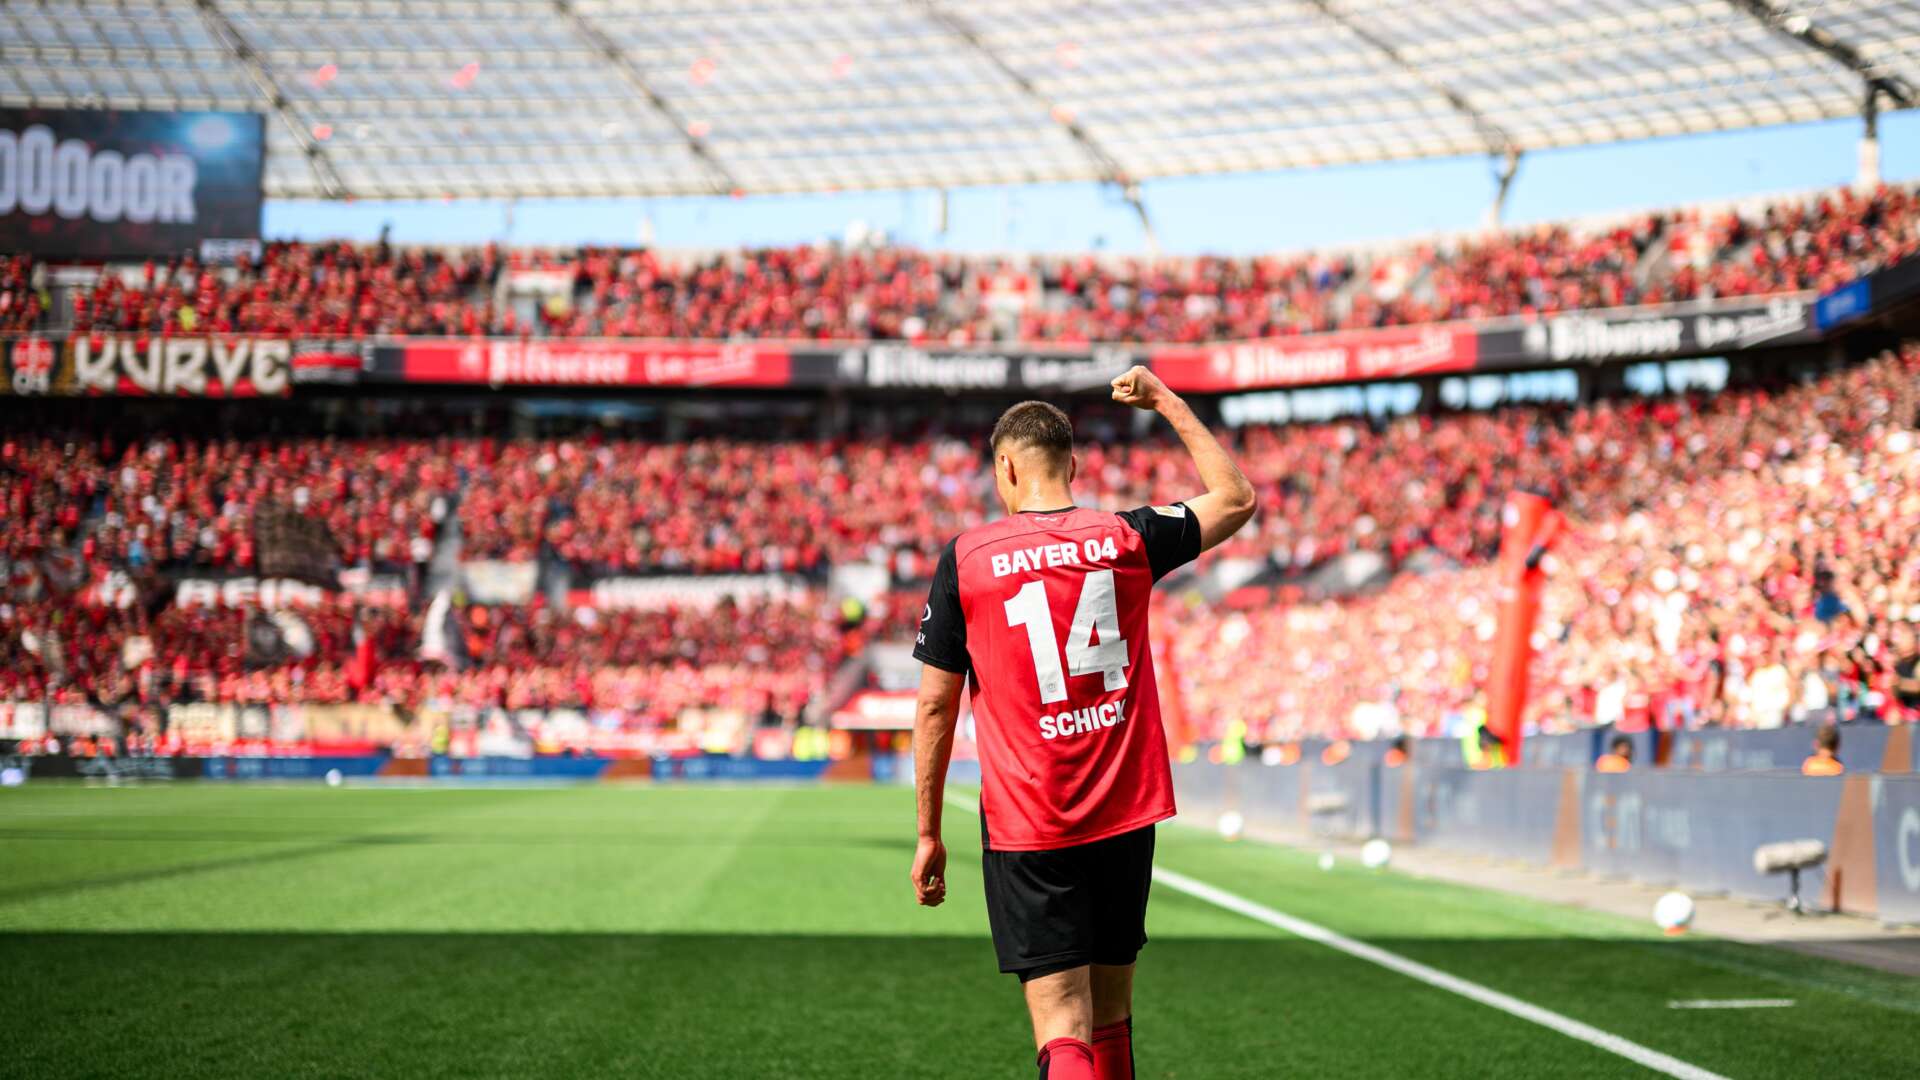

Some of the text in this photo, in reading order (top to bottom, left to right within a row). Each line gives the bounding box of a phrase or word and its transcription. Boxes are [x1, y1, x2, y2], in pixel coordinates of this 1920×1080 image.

[74, 334, 292, 396] KURVE
[991, 536, 1118, 577] BAYER 04
[1003, 568, 1130, 704] 14
[1039, 698, 1127, 740] SCHICK
